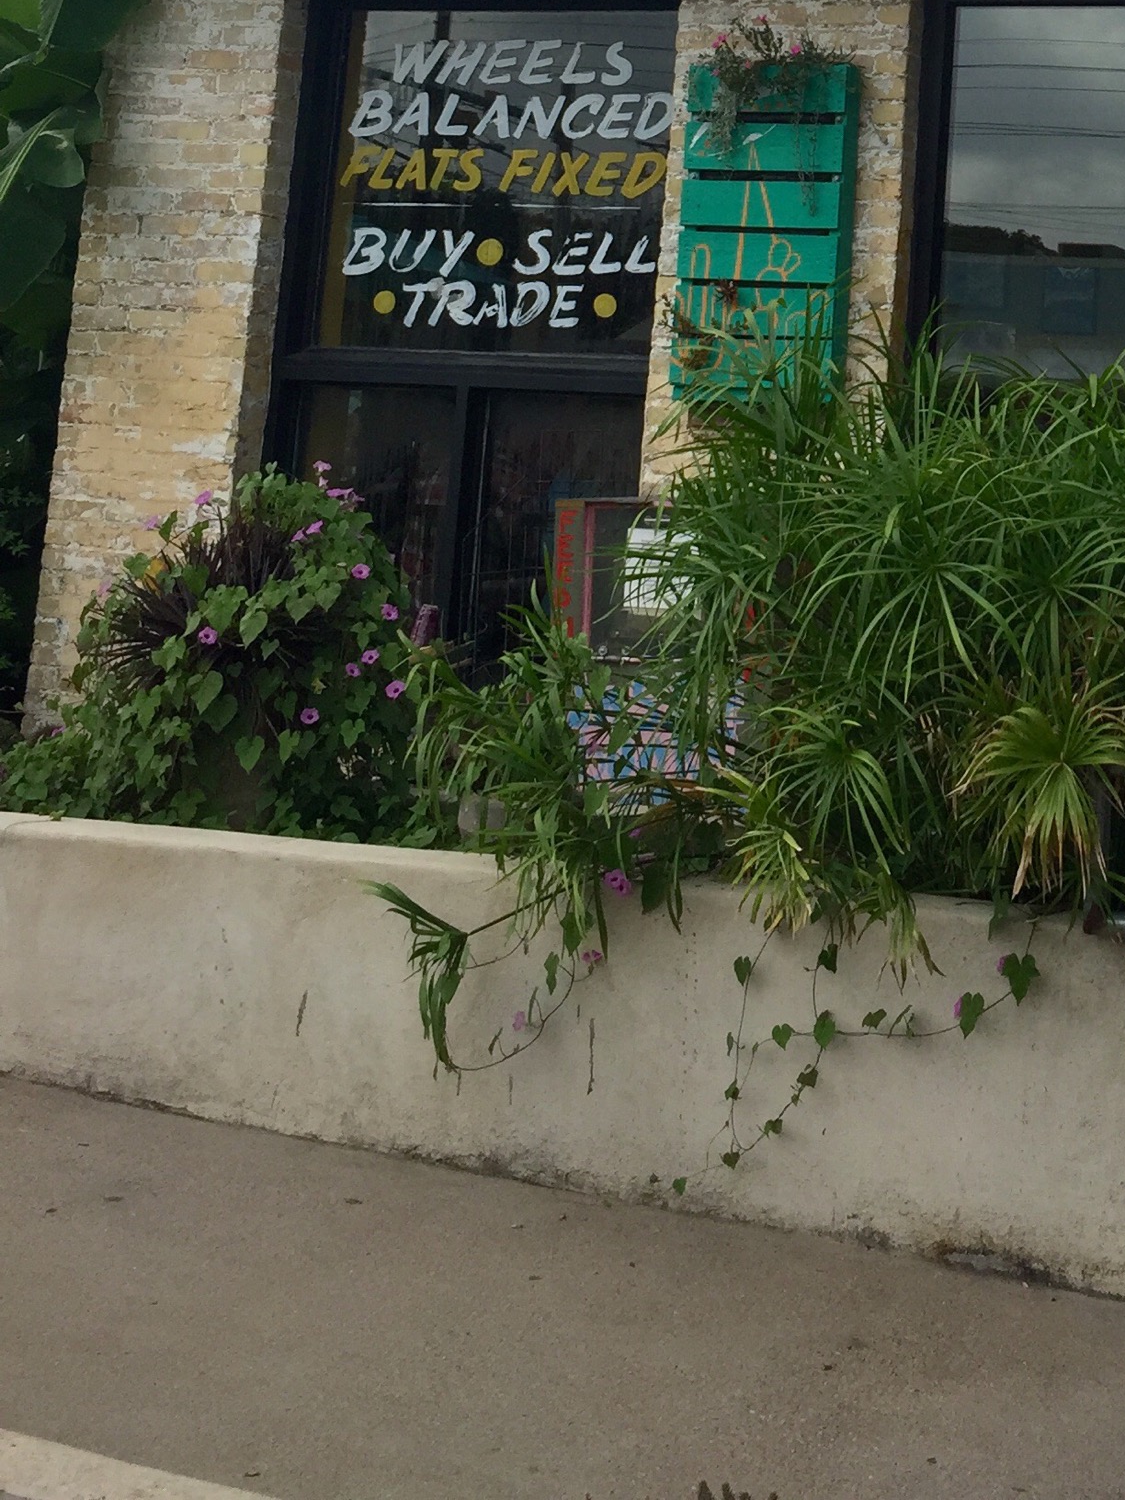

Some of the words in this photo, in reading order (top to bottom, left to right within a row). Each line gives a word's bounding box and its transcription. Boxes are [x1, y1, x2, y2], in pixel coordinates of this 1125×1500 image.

[392, 39, 634, 87] WHEELS
[348, 89, 675, 140] BALANCED
[339, 147, 485, 193] FLATS
[498, 149, 668, 199] FIXED
[342, 227, 477, 278] BUY
[512, 229, 658, 276] SELL
[402, 280, 586, 328] TRADE
